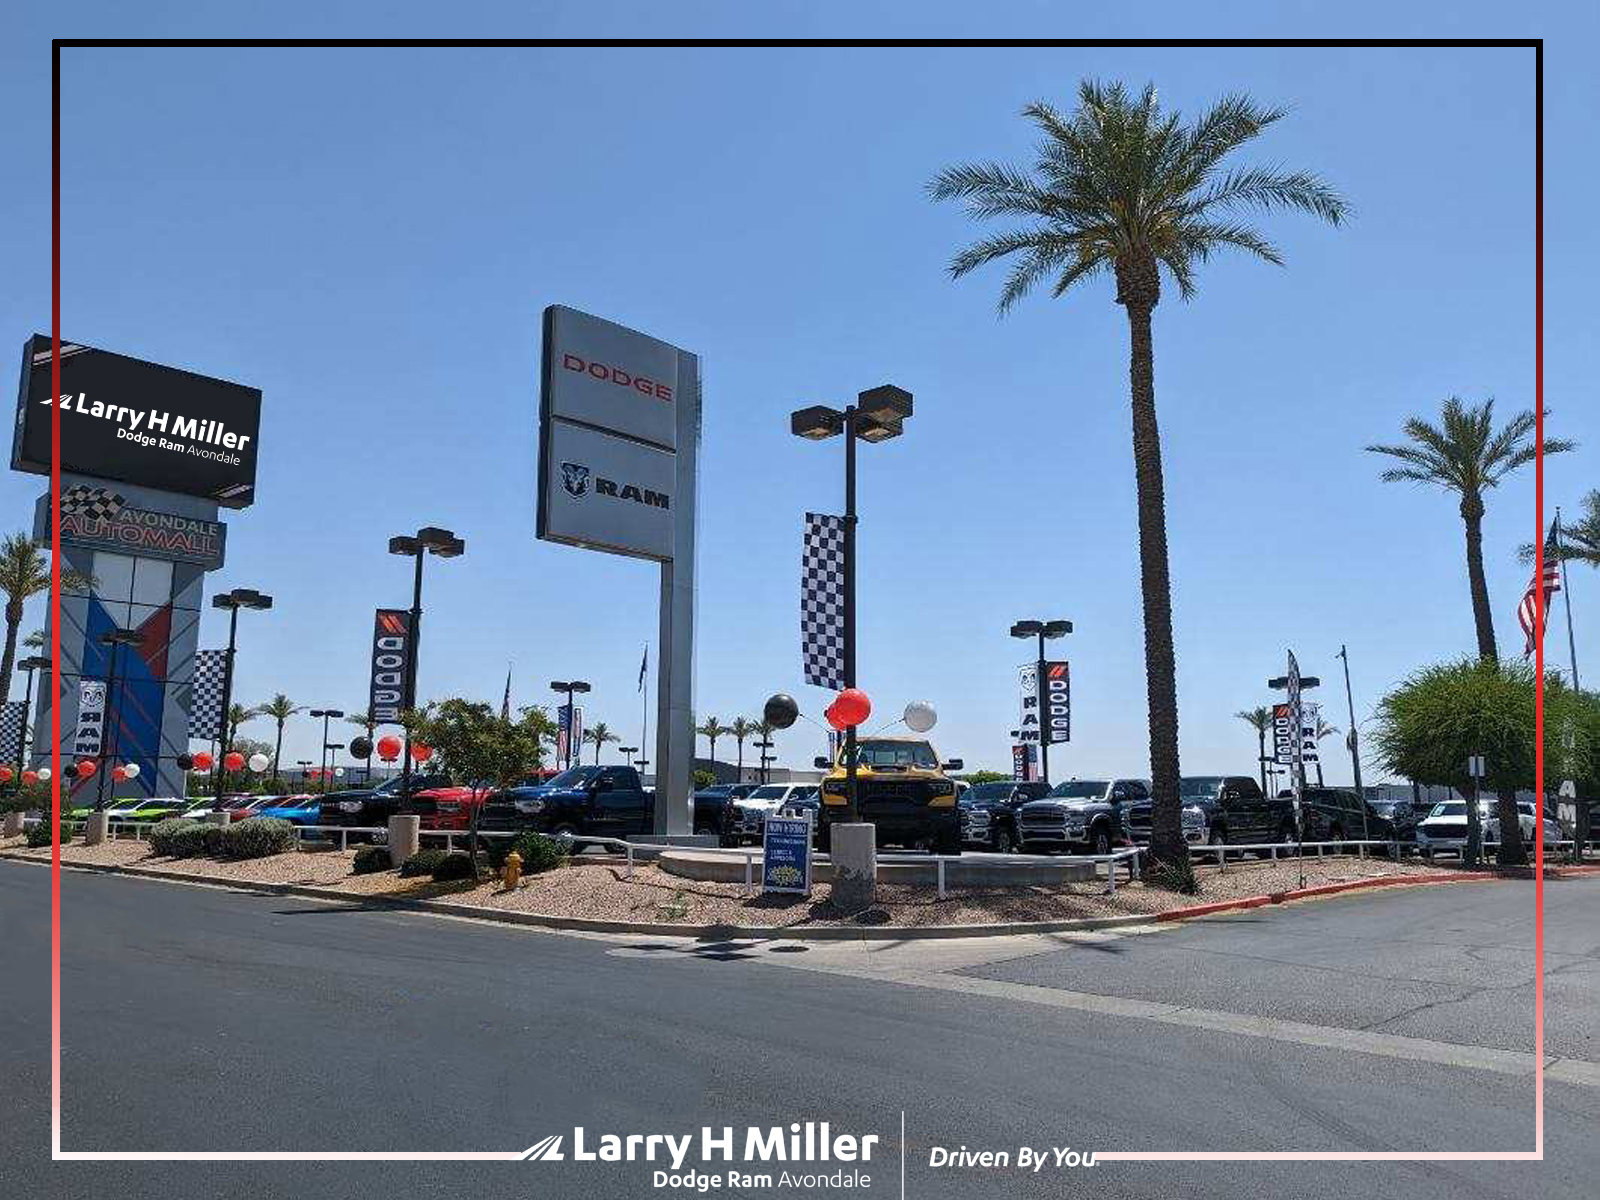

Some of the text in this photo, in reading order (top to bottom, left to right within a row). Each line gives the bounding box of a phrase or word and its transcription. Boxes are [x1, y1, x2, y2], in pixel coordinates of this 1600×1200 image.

[562, 354, 673, 402] DODGE
[76, 393, 251, 451] Larry H Miller
[116, 428, 241, 466] Dodge Ram Avondale
[595, 477, 670, 510] RAM
[60, 514, 219, 555] AUTOMALL
[119, 509, 219, 536] AVONDALE
[1020, 696, 1040, 741] RAM
[1049, 680, 1068, 741] DODGE
[1302, 727, 1319, 762] RAM
